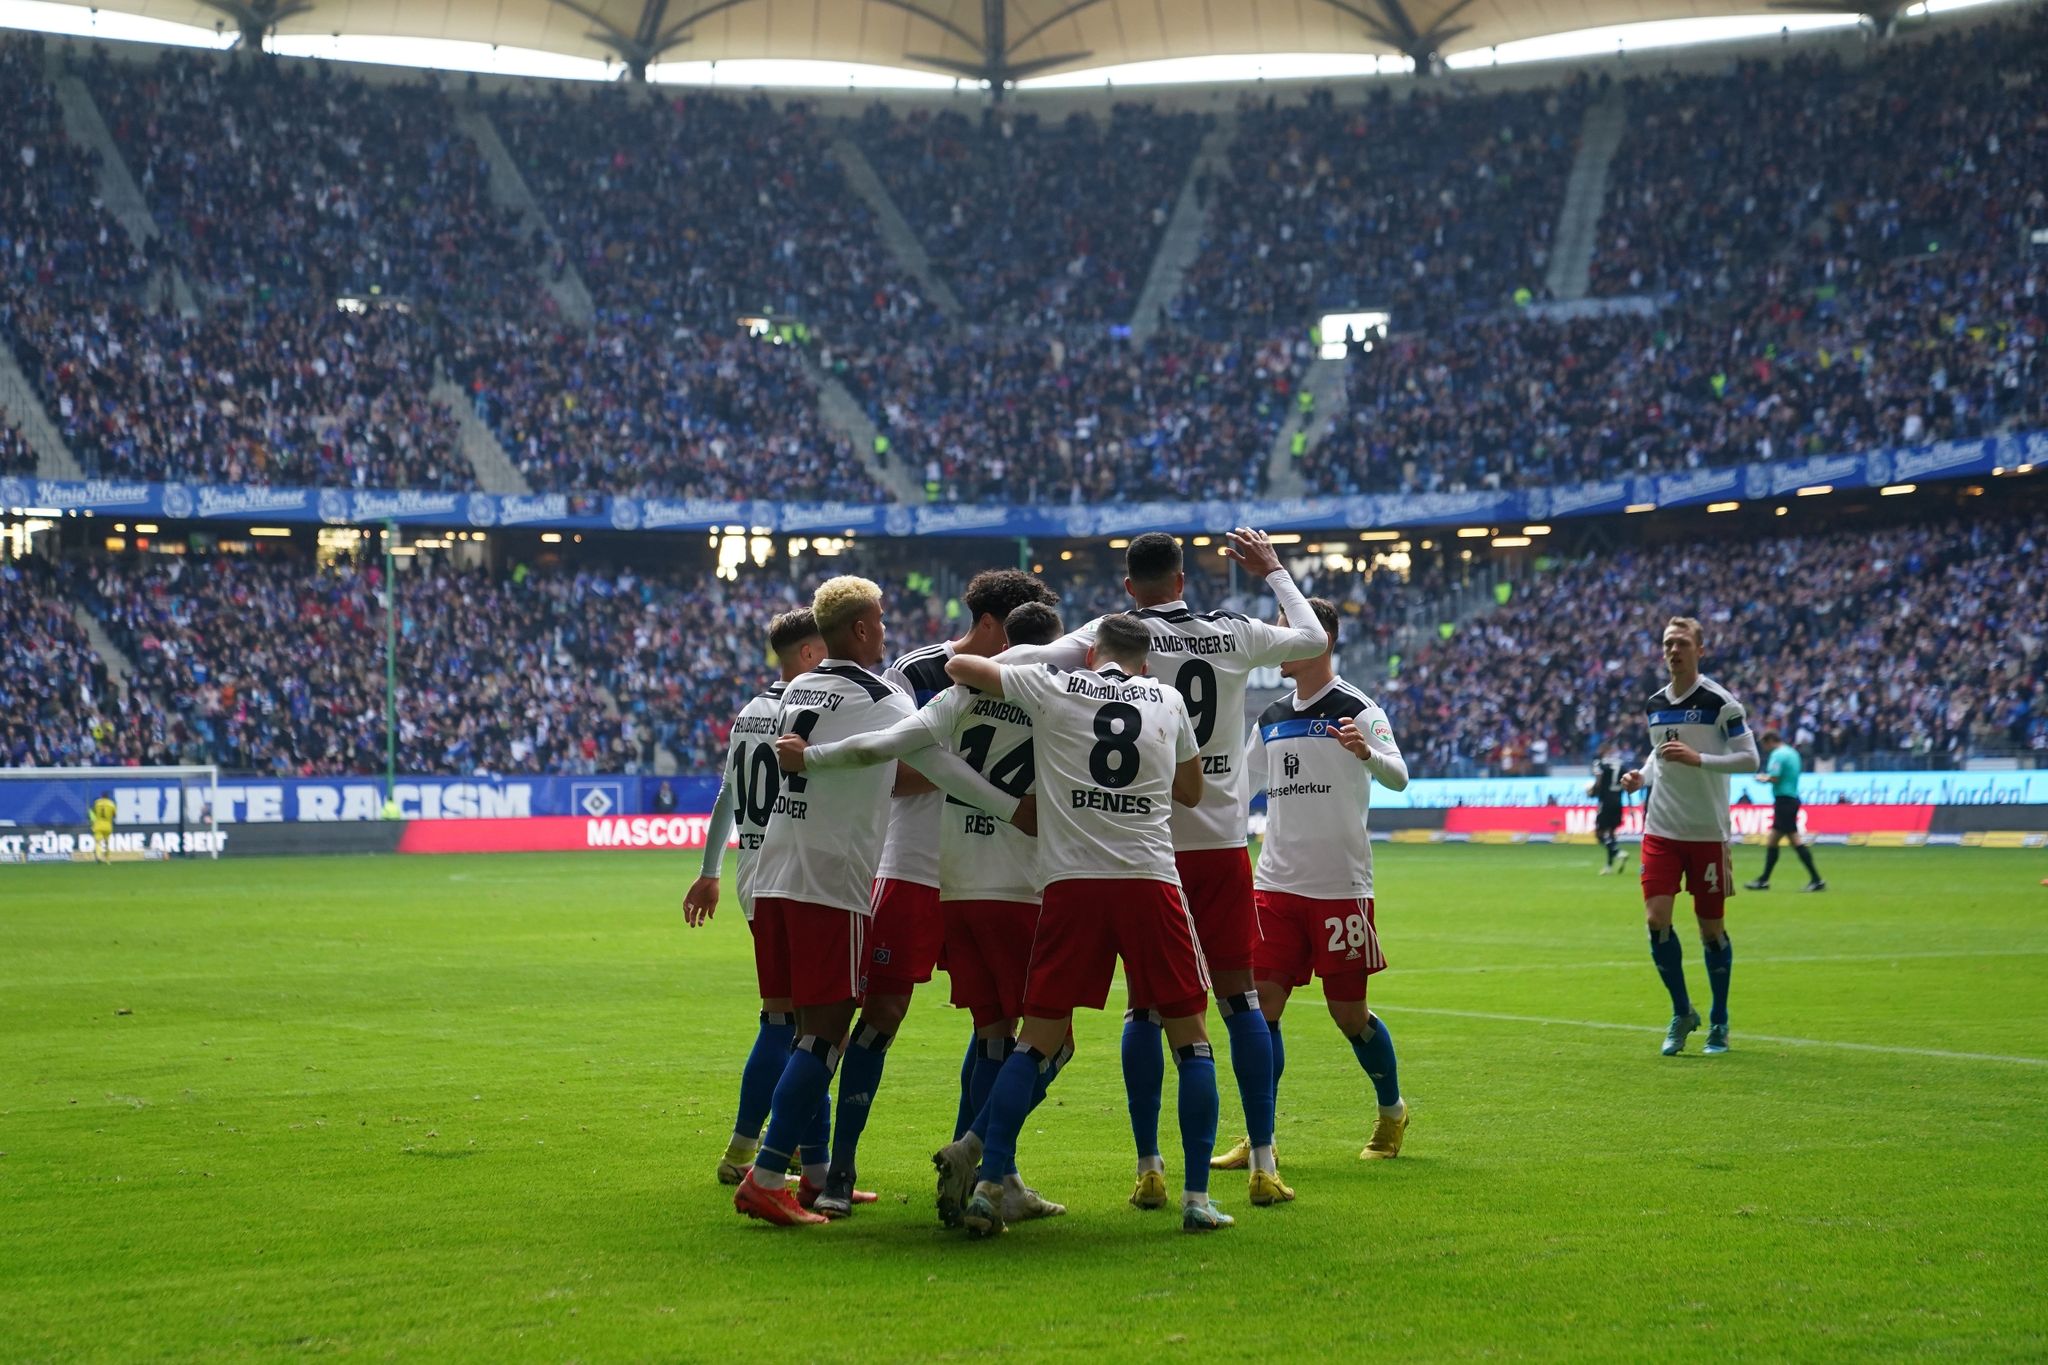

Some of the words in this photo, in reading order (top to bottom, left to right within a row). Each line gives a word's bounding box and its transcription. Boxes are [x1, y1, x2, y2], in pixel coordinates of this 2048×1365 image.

[1150, 635, 1221, 654] AMBURGER
[822, 693, 845, 712] SV
[1175, 658, 1217, 749] 9
[769, 718, 778, 735] S
[1089, 701, 1142, 789] 8
[1201, 755, 1231, 775] ZEL
[732, 740, 780, 828] 10
[297, 784, 531, 821] RACISM
[1071, 787, 1151, 815] BÉNES
[29, 830, 74, 853] FÜR
[1704, 861, 1719, 884] 4
[1325, 914, 1365, 952] 28
